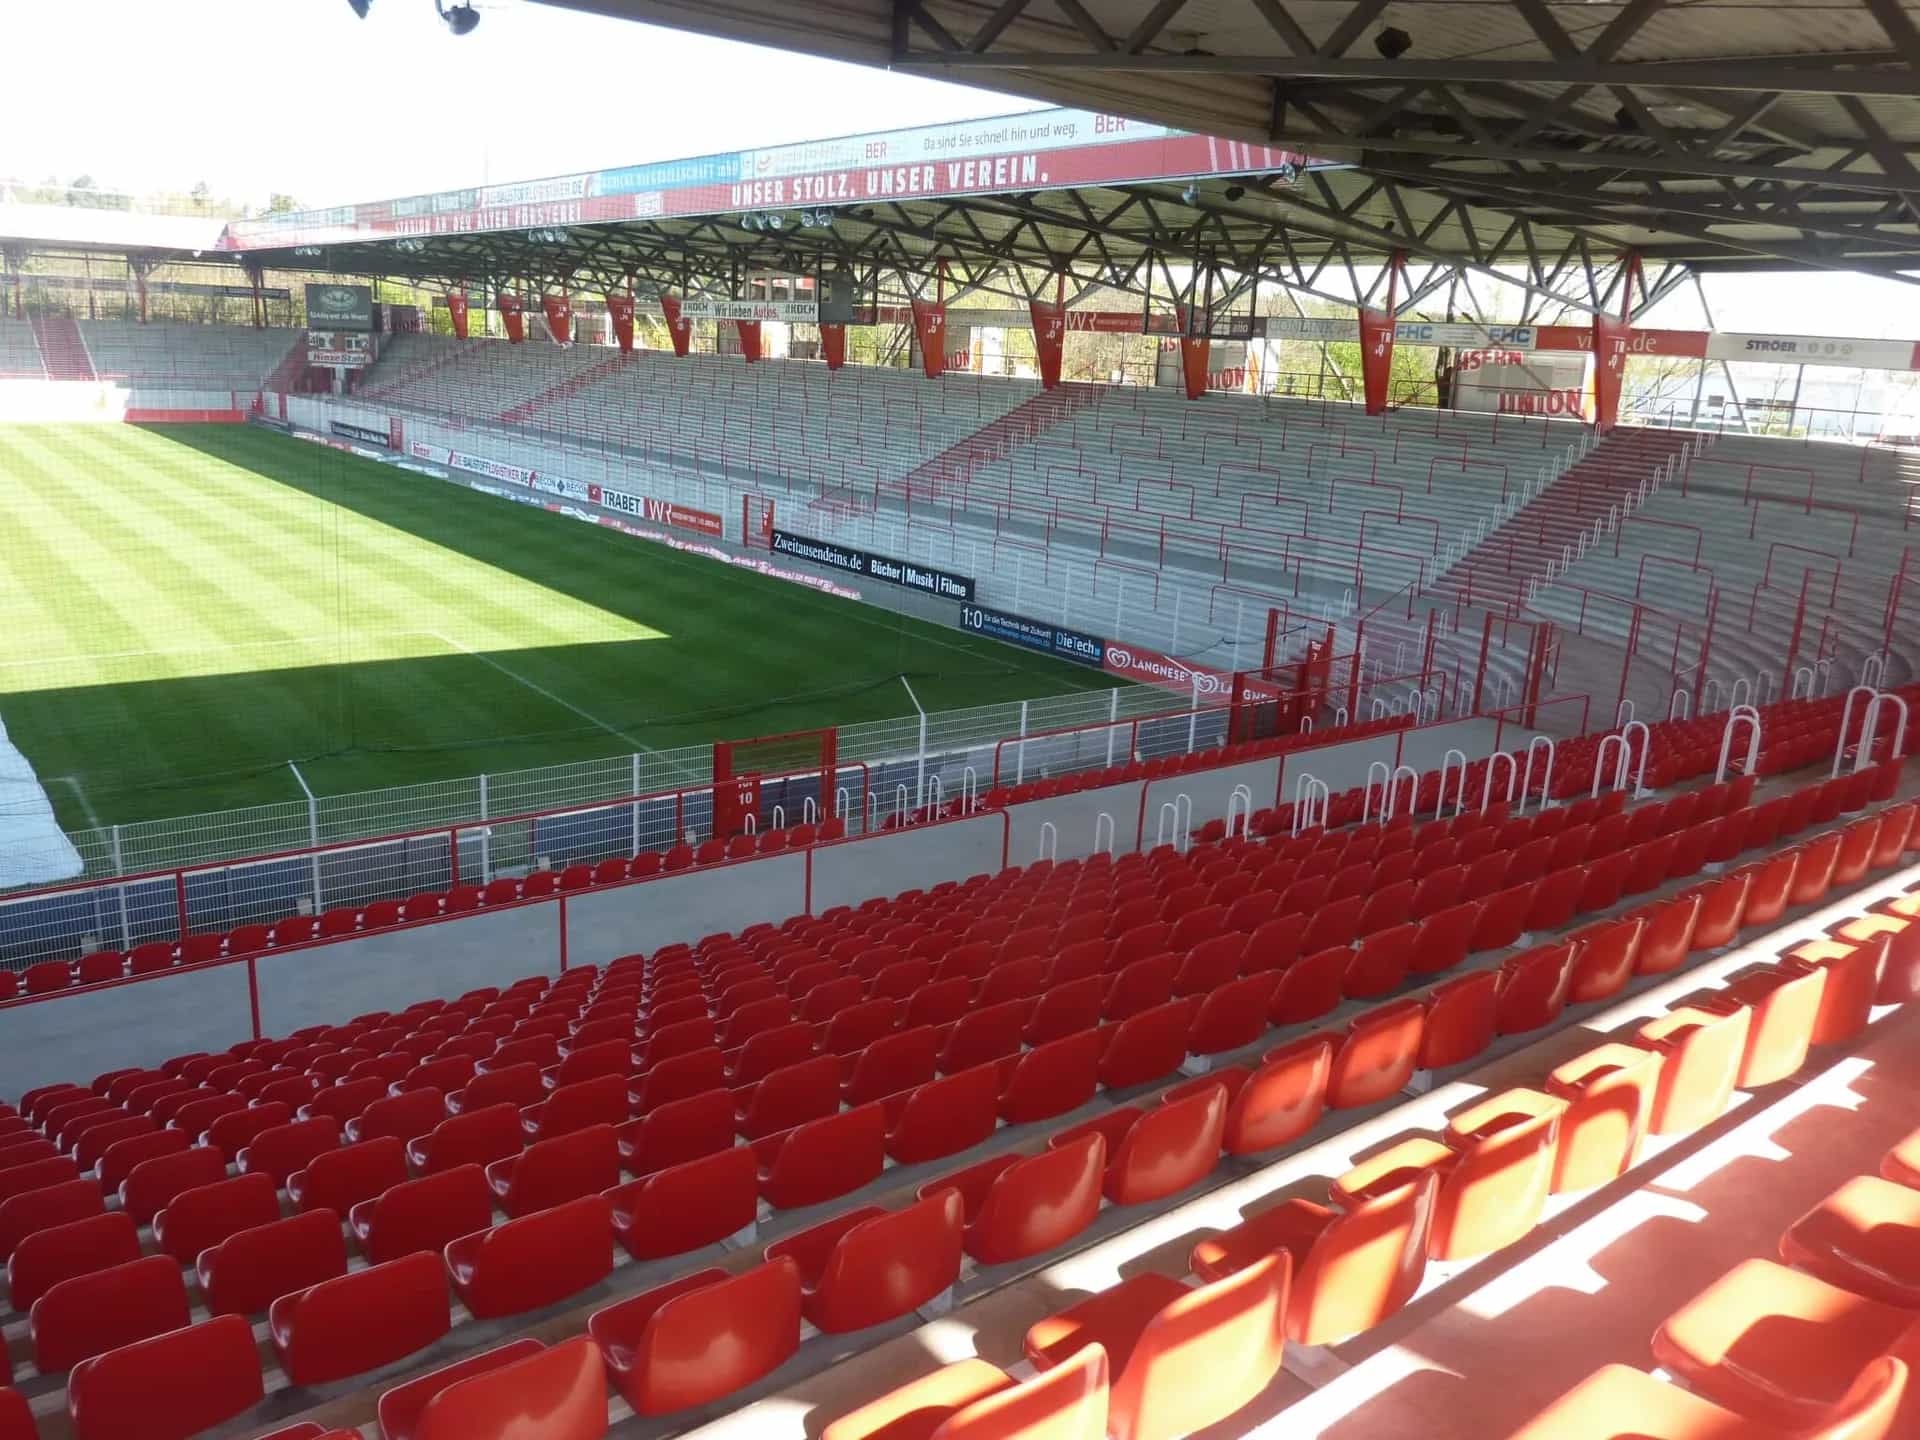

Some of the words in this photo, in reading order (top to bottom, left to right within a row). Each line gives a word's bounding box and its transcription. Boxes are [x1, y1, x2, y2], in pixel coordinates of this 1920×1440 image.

[937, 135, 956, 149] sind
[975, 129, 1008, 145] schnell
[1011, 128, 1027, 142] hin
[1029, 123, 1050, 138] und
[1094, 114, 1126, 134] BER
[865, 142, 887, 159] BER
[731, 180, 784, 207] UNSER
[793, 173, 855, 200] STOLZ.
[867, 165, 935, 196] UNSER
[948, 156, 1049, 188] VEREIN.
[715, 303, 726, 317] Wir
[728, 304, 751, 317] lieben
[602, 489, 641, 513] TRABET
[773, 533, 863, 571] Zweitausendeins.de
[871, 559, 901, 579] Bücher
[907, 568, 933, 588] Musik
[941, 577, 967, 597] Filme
[962, 606, 983, 629] 1:0
[1056, 631, 1094, 655] DieTech
[1131, 657, 1186, 682] LANGNESE
[739, 791, 753, 806] 10
